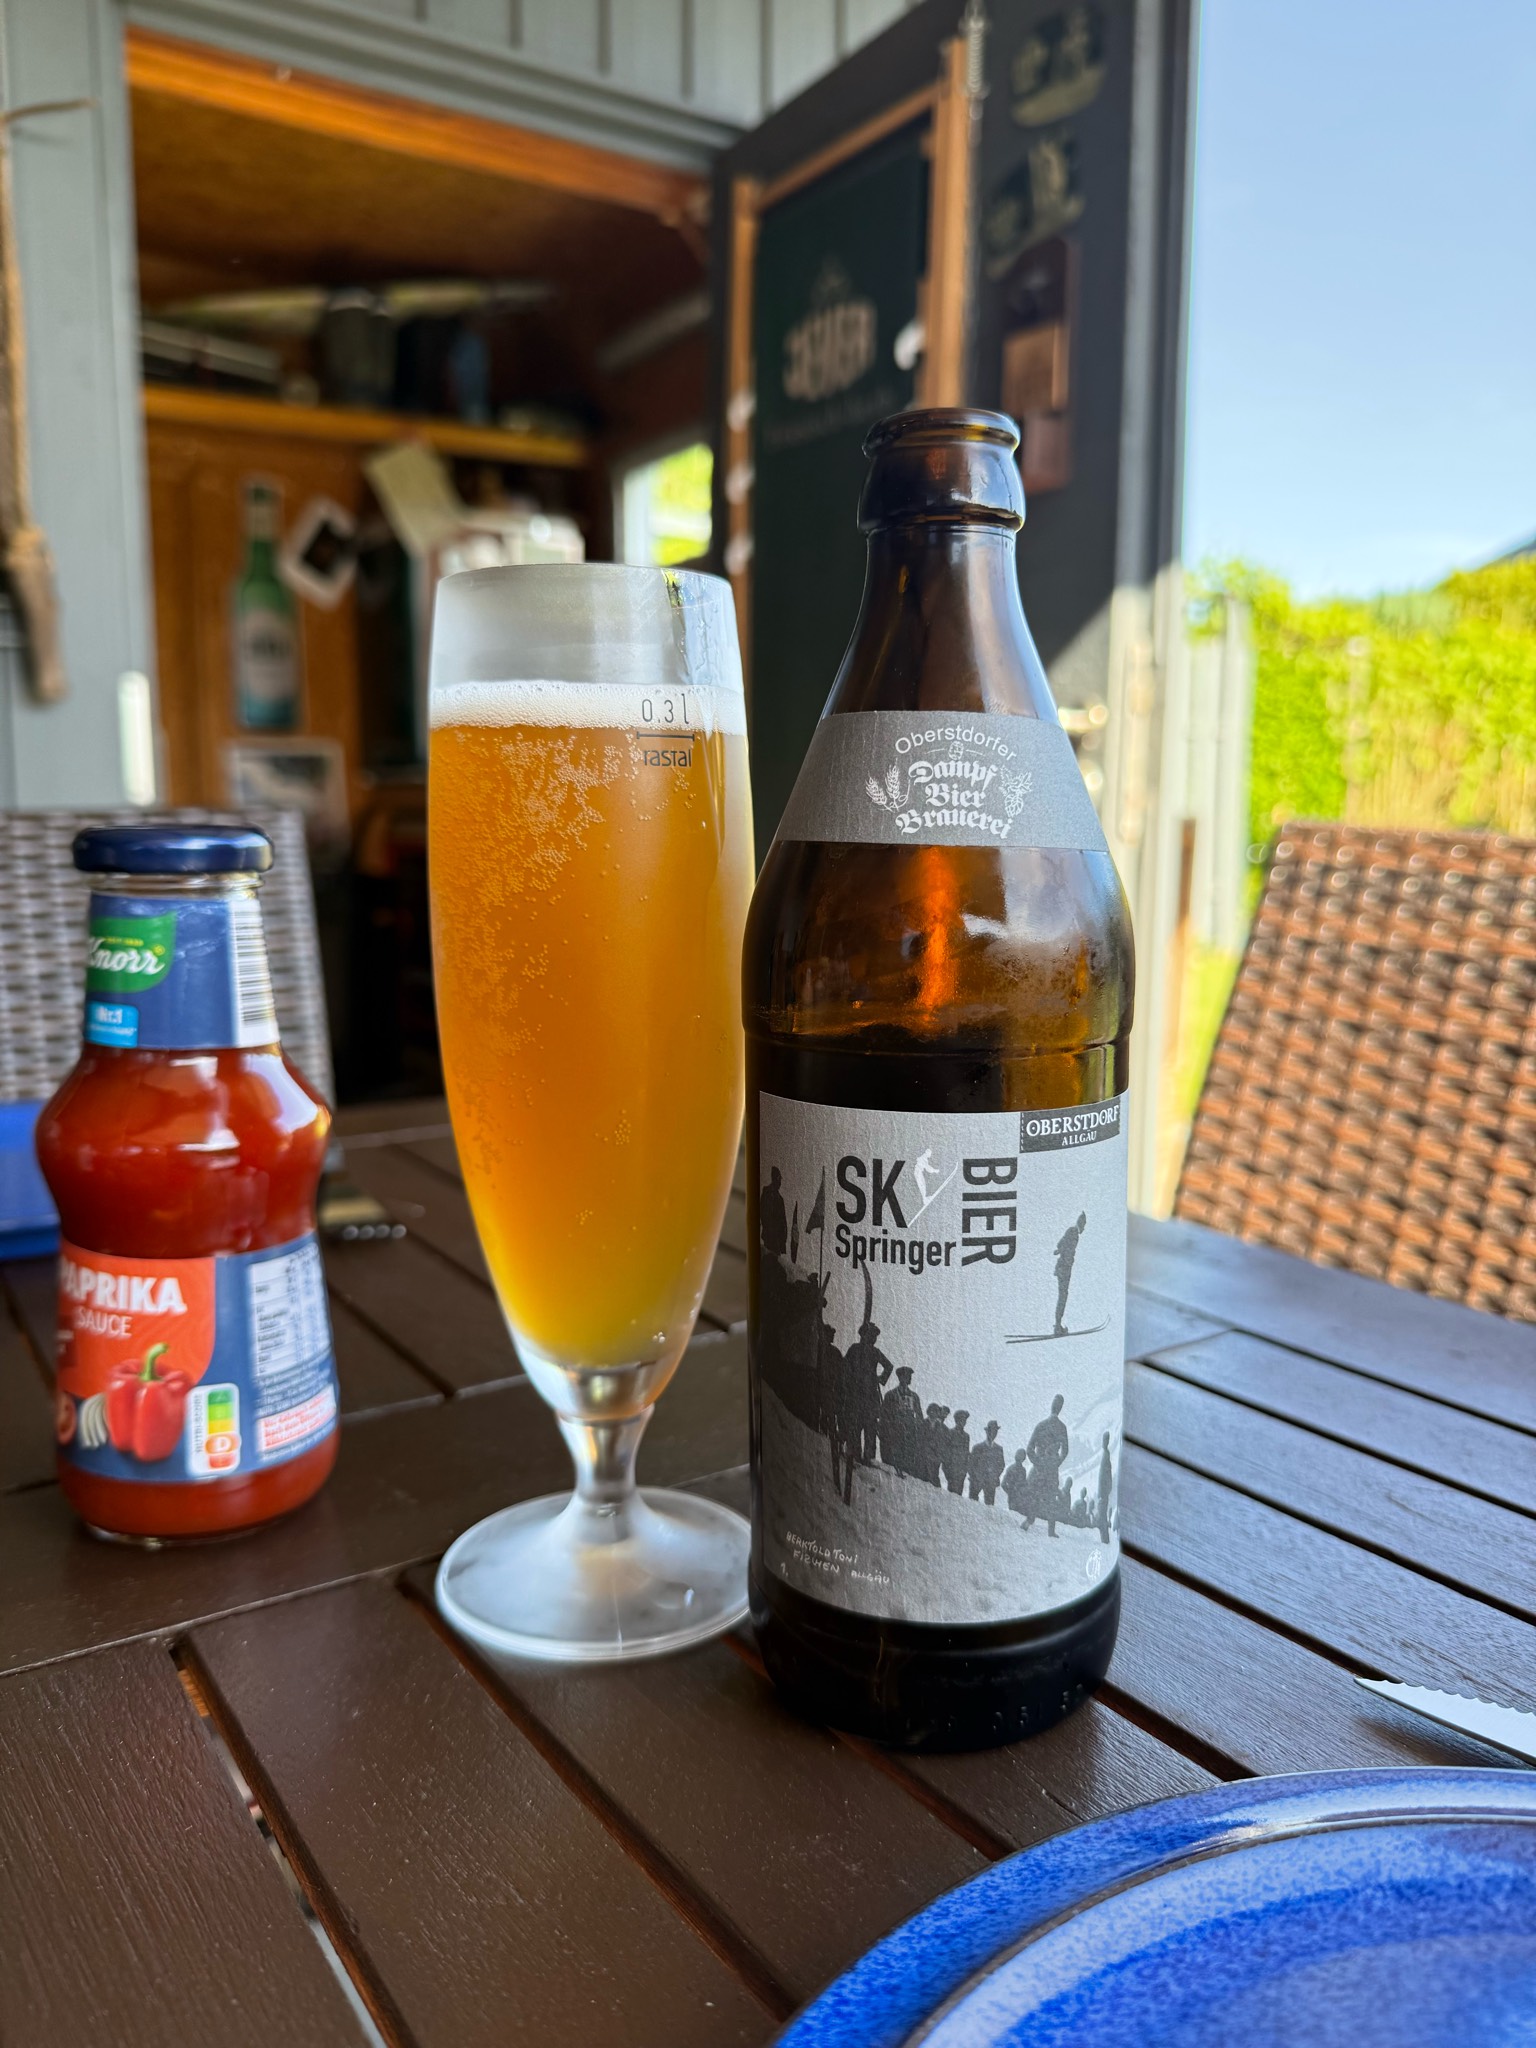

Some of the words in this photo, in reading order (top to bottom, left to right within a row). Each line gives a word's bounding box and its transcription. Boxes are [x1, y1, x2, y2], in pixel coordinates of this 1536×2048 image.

[643, 749, 692, 767] rastal
[895, 725, 1017, 761] Oberstdorfer
[908, 760, 998, 792] Dampf
[925, 783, 986, 808] Bier
[895, 808, 1013, 839] Brauerei
[1026, 1105, 1119, 1137] OBERSTDORF
[1061, 1129, 1097, 1146] ALLGÄU
[961, 1157, 1018, 1266] BIER
[835, 1224, 957, 1275] Springer
[75, 1306, 132, 1339] SAUCE
[786, 1531, 831, 1557] BERKTOLD
